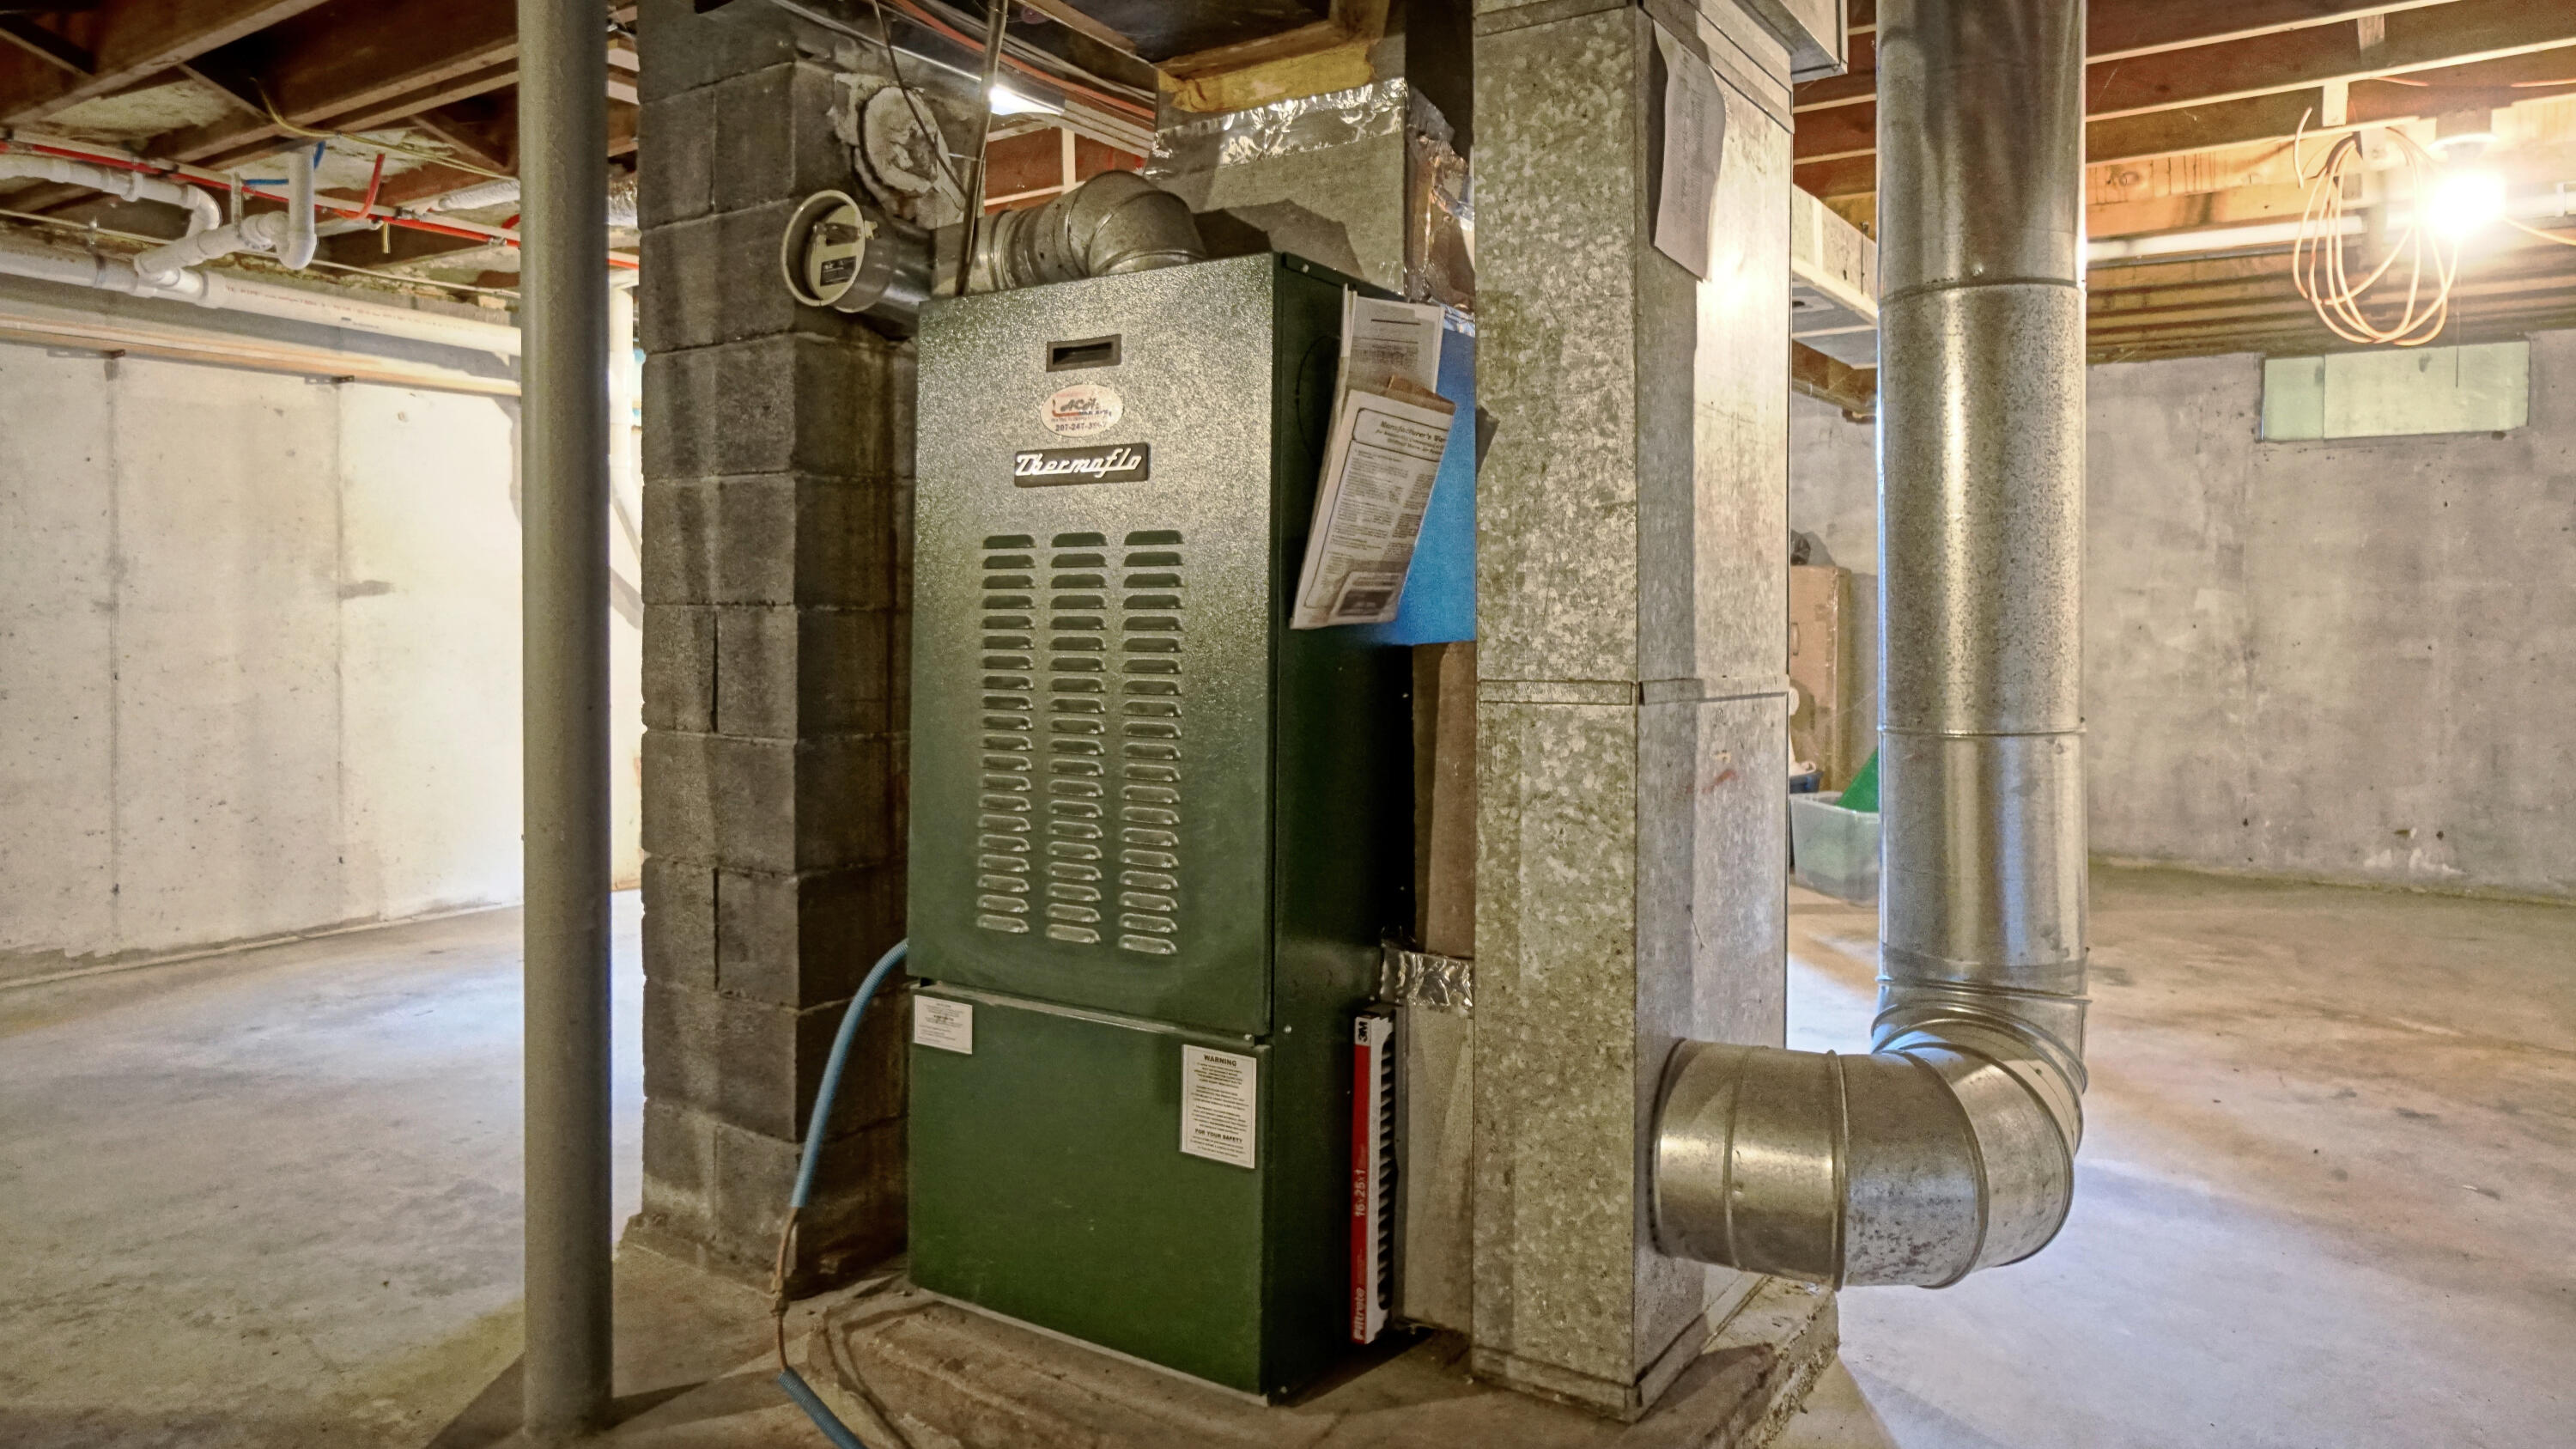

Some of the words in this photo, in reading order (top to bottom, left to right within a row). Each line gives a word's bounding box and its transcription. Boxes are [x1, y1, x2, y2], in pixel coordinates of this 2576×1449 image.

[1015, 447, 1142, 478] Thermaflo
[1358, 1020, 1368, 1043] 3M
[1203, 1054, 1237, 1067] WARNING
[1222, 1134, 1242, 1143] SAFETY
